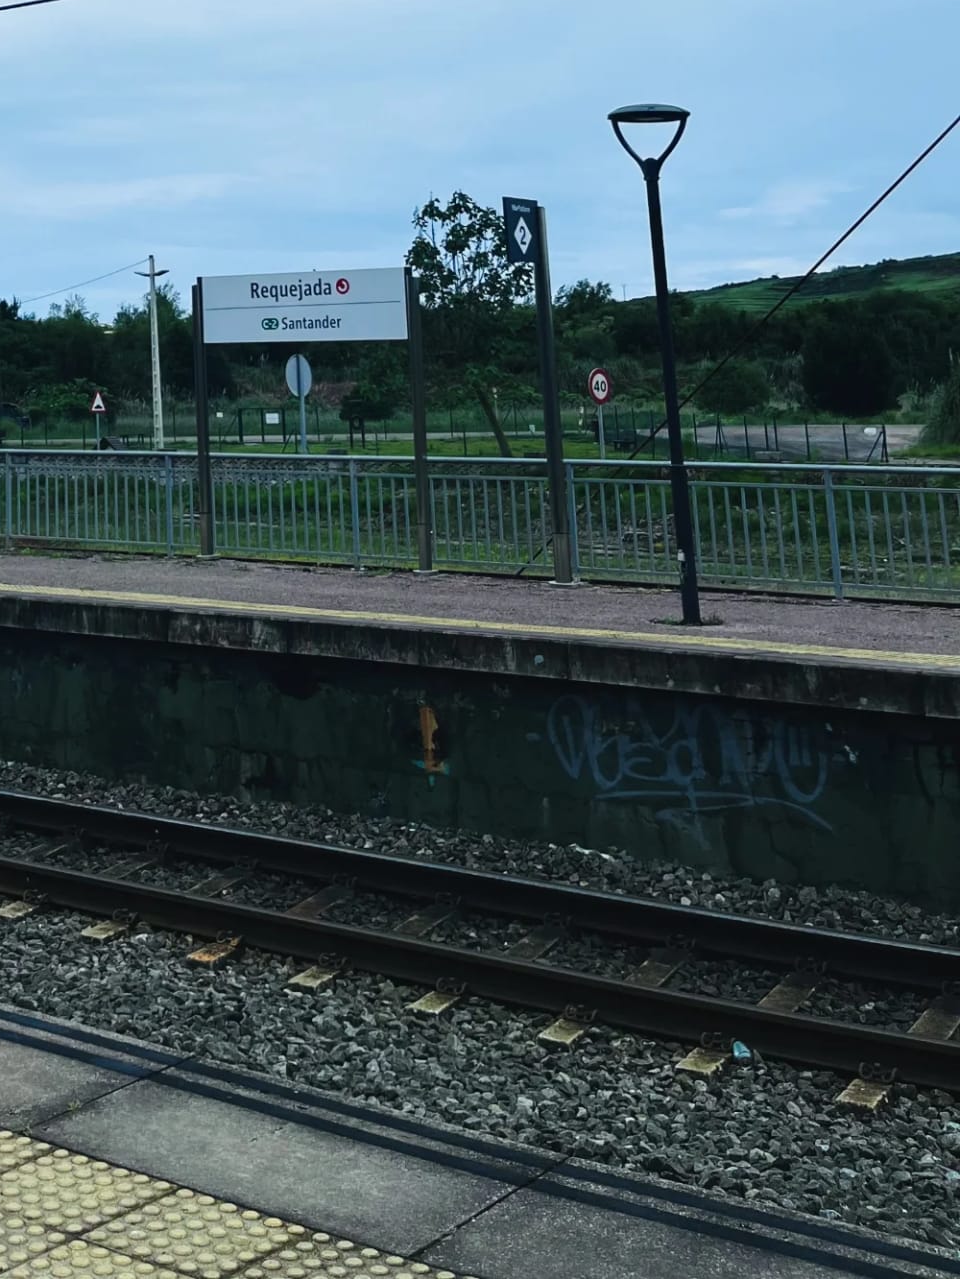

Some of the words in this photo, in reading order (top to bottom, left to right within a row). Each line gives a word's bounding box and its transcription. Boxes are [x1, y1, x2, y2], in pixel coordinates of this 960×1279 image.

[519, 225, 527, 246] 2
[250, 278, 332, 302] Requejada
[262, 318, 279, 330] C-2
[281, 315, 342, 330] Santander
[593, 380, 607, 393] 40
